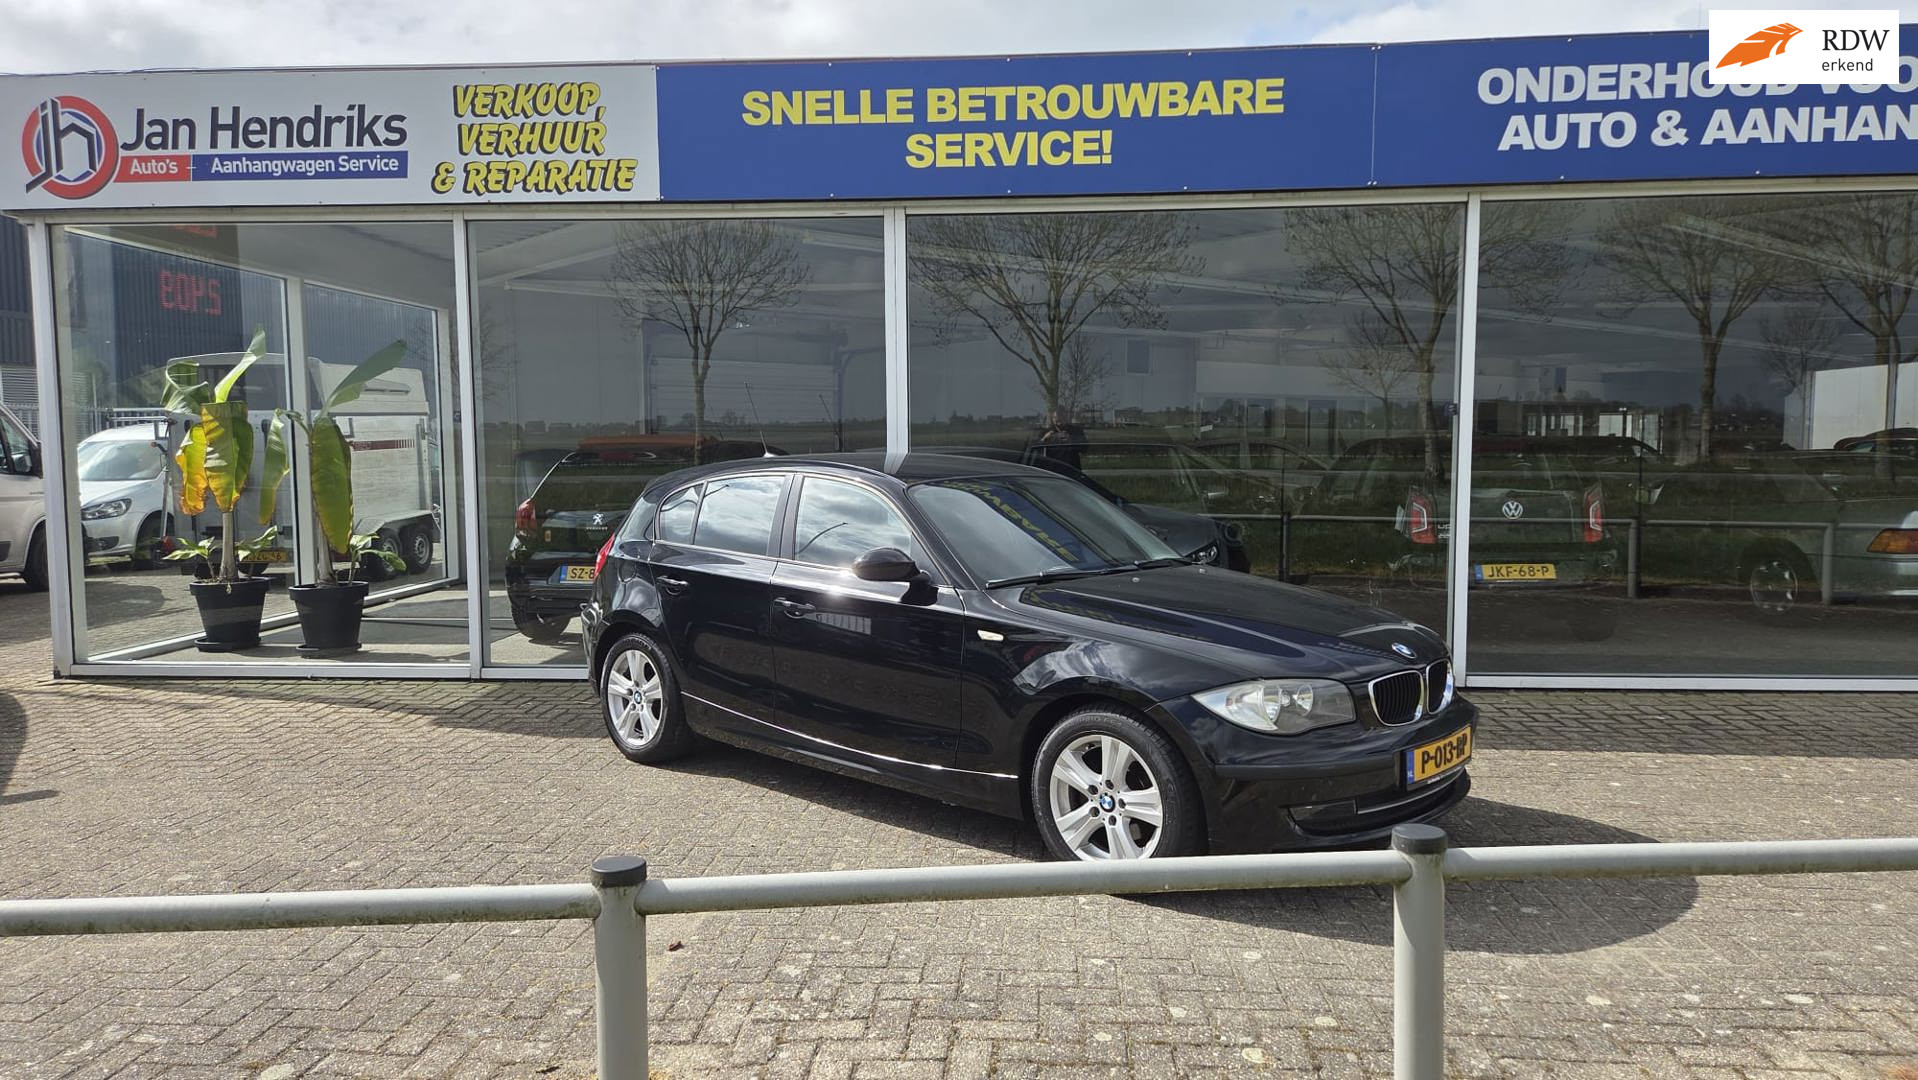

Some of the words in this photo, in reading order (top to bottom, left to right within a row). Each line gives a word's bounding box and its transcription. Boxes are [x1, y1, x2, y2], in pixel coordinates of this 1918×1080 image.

[453, 82, 606, 121] VERKOOP,
[742, 89, 914, 126] SNELLE
[927, 78, 1285, 123] BETROUWBARE
[120, 108, 196, 151] Jan
[210, 104, 408, 149] Hendriks
[458, 121, 607, 158] VERHUUR
[1497, 111, 1637, 151] AUTO
[1650, 110, 1689, 147] &
[130, 158, 178, 175] Auto's
[211, 157, 335, 177] Aanhangwagen
[338, 154, 399, 173] Service
[906, 130, 1112, 168] SERVICE!
[431, 161, 456, 194] &
[463, 159, 638, 195] REPARATIE
[1488, 565, 1549, 578] JKF-68-P
